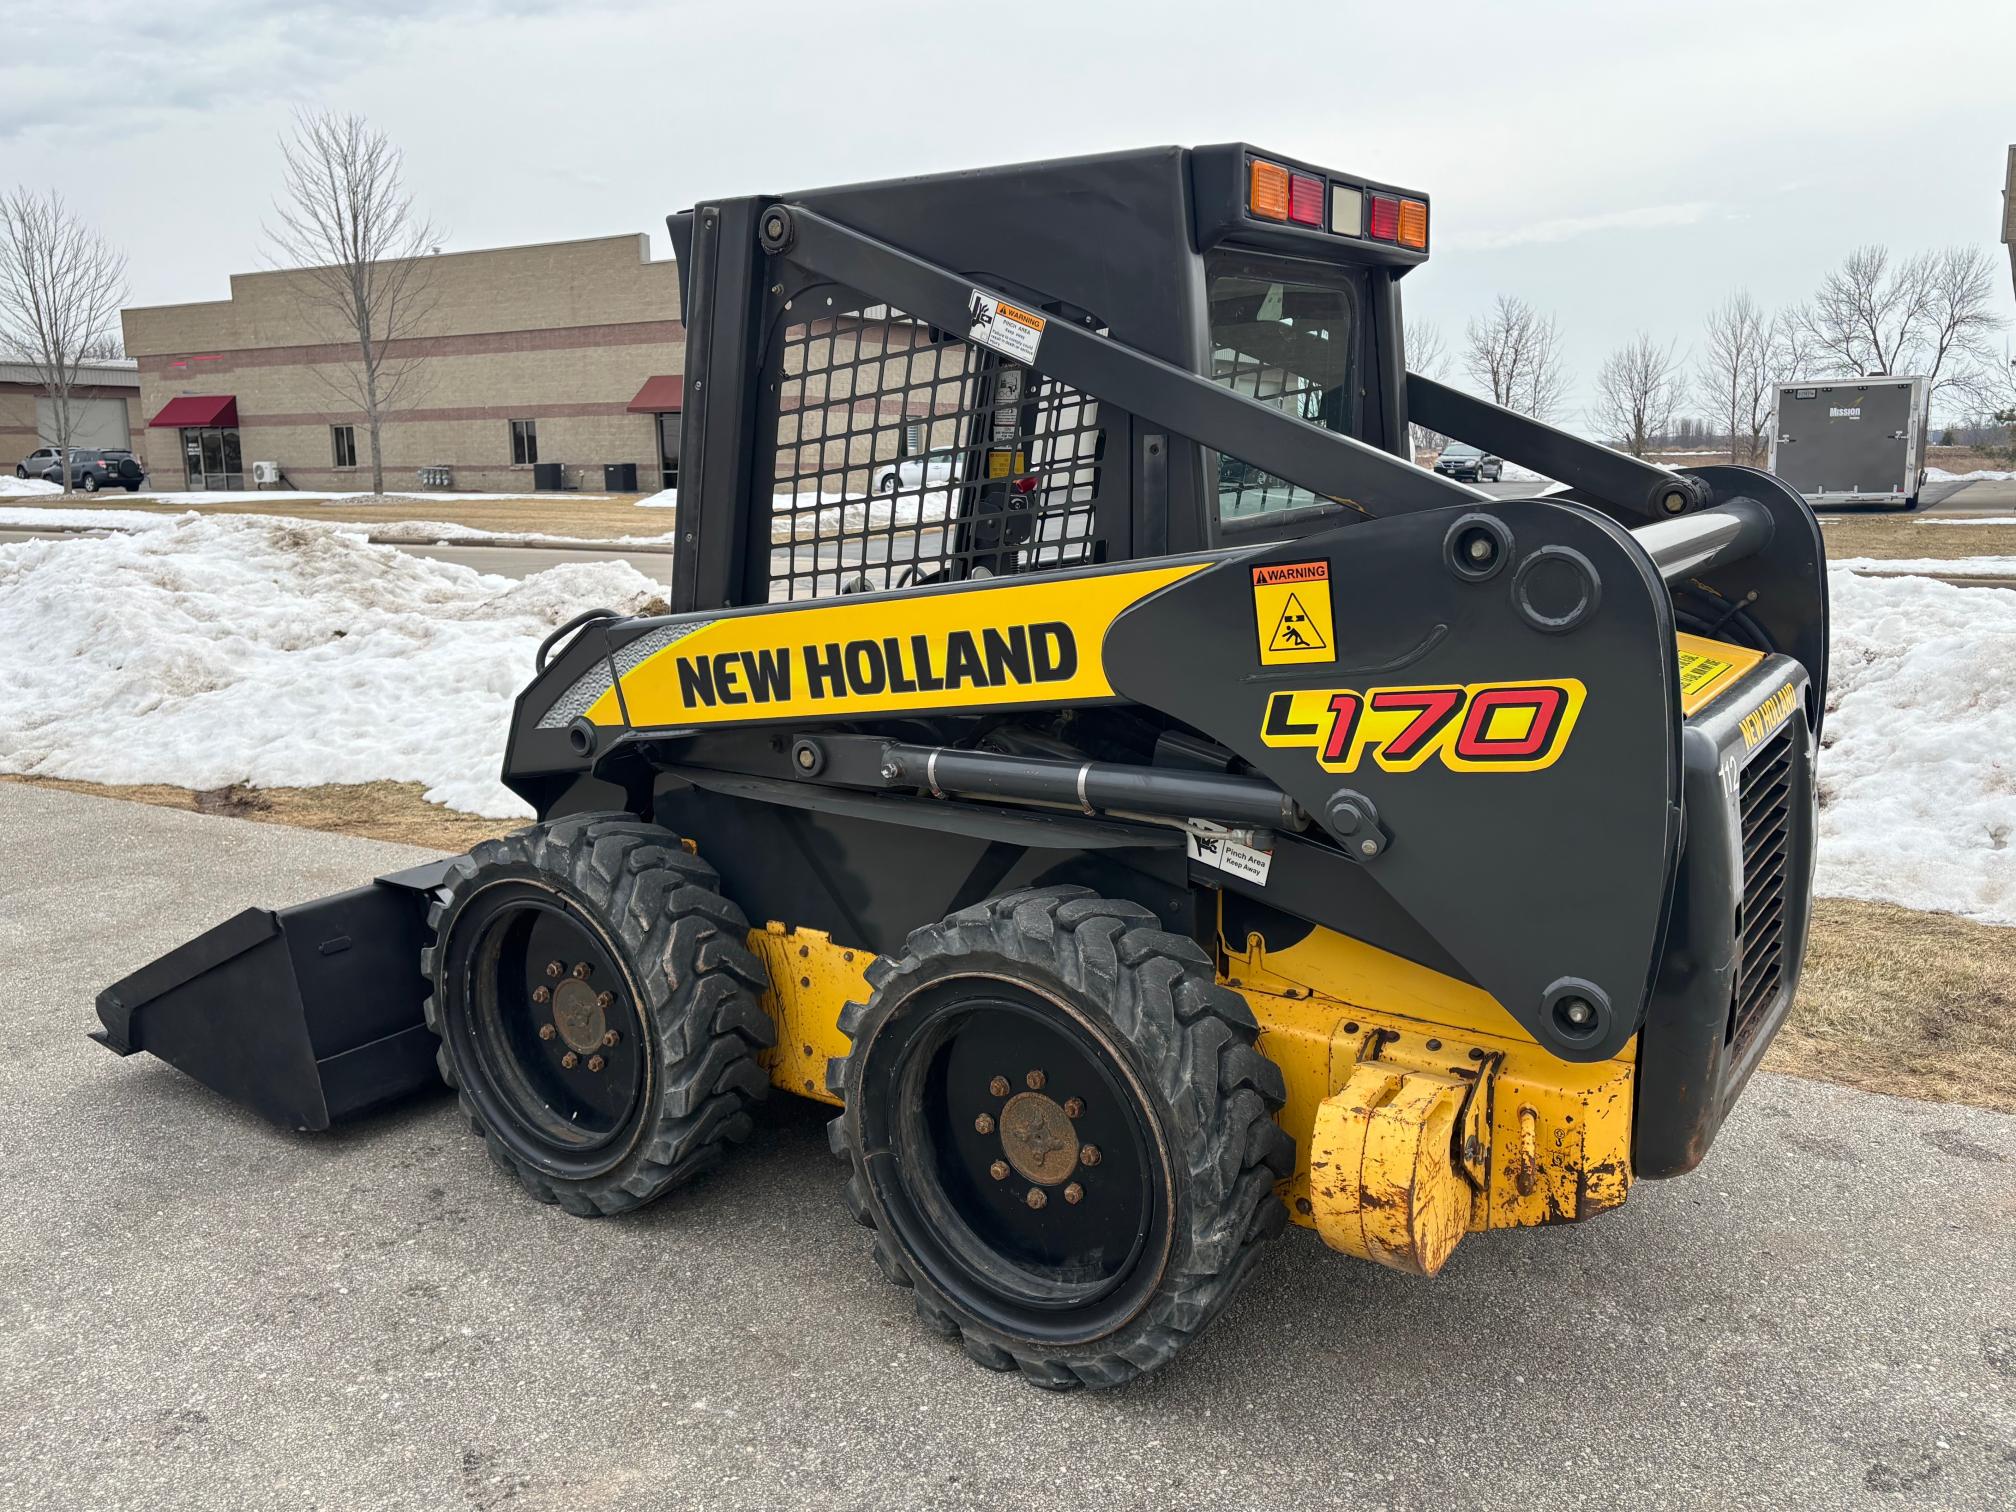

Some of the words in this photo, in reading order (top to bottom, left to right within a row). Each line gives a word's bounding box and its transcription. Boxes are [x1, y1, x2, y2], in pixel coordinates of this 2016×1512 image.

[1008, 309, 1040, 327] WARNING
[1829, 407, 1861, 417] Mission
[1267, 566, 1325, 581] WARNING
[676, 647, 791, 709] NEW
[803, 620, 1079, 700] HOLLAND
[1738, 709, 1765, 751] NEW
[1758, 682, 1797, 734] HOLLAND
[1718, 755, 1740, 798] 112
[1225, 847, 1247, 860] Pinch
[1247, 855, 1266, 868] Area
[1226, 857, 1243, 869] Keep
[1242, 864, 1261, 876] Away
